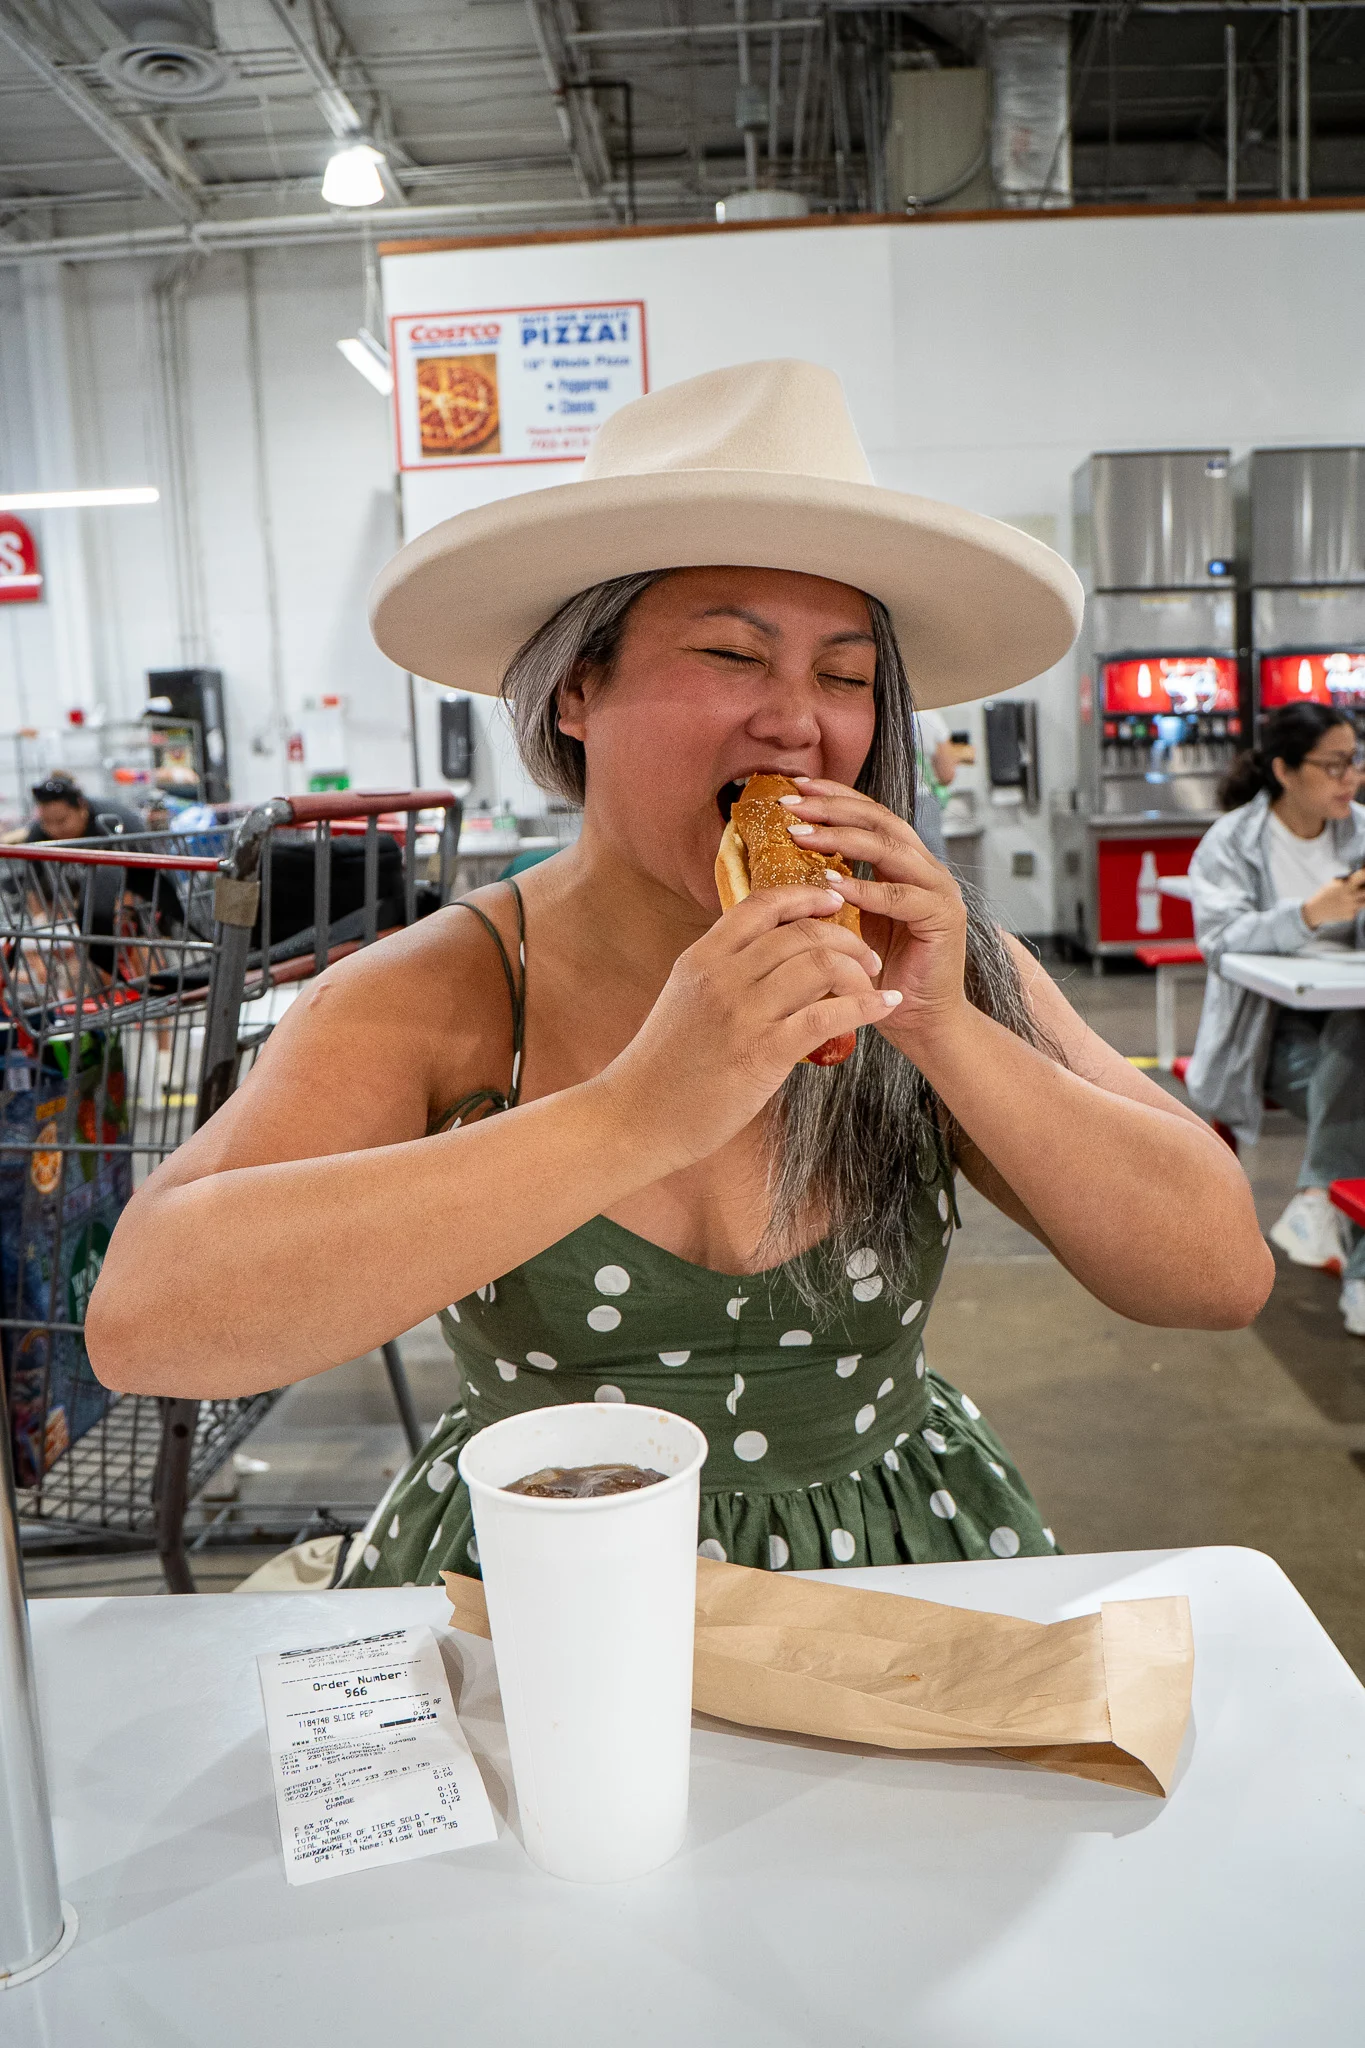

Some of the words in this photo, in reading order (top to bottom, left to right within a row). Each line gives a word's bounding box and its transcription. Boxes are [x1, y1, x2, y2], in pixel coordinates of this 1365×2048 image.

[522, 321, 628, 346] PIZZA!
[312, 1680, 350, 1692] Order
[358, 1670, 408, 1686] Number:
[344, 1686, 368, 1698] 966
[298, 1716, 330, 1728] 1184748
[334, 1712, 356, 1723] SLICE
[360, 1710, 374, 1719] PEP
[312, 1726, 327, 1736] TAX
[413, 1708, 431, 1716] 0.22
[314, 1734, 336, 1743] TOTAL
[284, 1778, 322, 1792] APPROVED
[334, 1764, 372, 1778] Purchase
[284, 1785, 317, 1796] AMOUNT:
[322, 1778, 345, 1787] $2.21
[324, 1795, 345, 1804] Visa
[432, 1766, 451, 1775] 2.21
[338, 1778, 361, 1788] 14:24
[365, 1774, 379, 1782] 233
[384, 1769, 398, 1777] 235
[305, 1824, 330, 1836] 5.00%
[335, 1818, 349, 1827] TAX
[439, 1788, 459, 1798] 0.10
[319, 1817, 334, 1825] TAX
[437, 1782, 457, 1792] 0.12
[326, 1798, 356, 1810] CHANGE
[296, 1835, 320, 1845] TOTAL
[326, 1828, 340, 1837] TAX
[441, 1794, 461, 1805] 0.22
[349, 1835, 373, 1846] 14:24
[378, 1829, 392, 1839] 233
[398, 1824, 412, 1834] 235
[416, 1820, 425, 1828] 81
[431, 1815, 447, 1824] 735
[294, 1843, 318, 1854] TOTAL
[322, 1832, 352, 1846] NUMBER
[356, 1828, 366, 1836] OF
[371, 1820, 396, 1832] ITEMS
[400, 1814, 421, 1824] SOLD
[314, 1854, 334, 1863] OP#:
[340, 1848, 355, 1857] 735
[359, 1841, 384, 1852] Name:
[389, 1832, 414, 1844] Kiosk
[418, 1826, 438, 1837] User
[443, 1820, 458, 1830] 735
